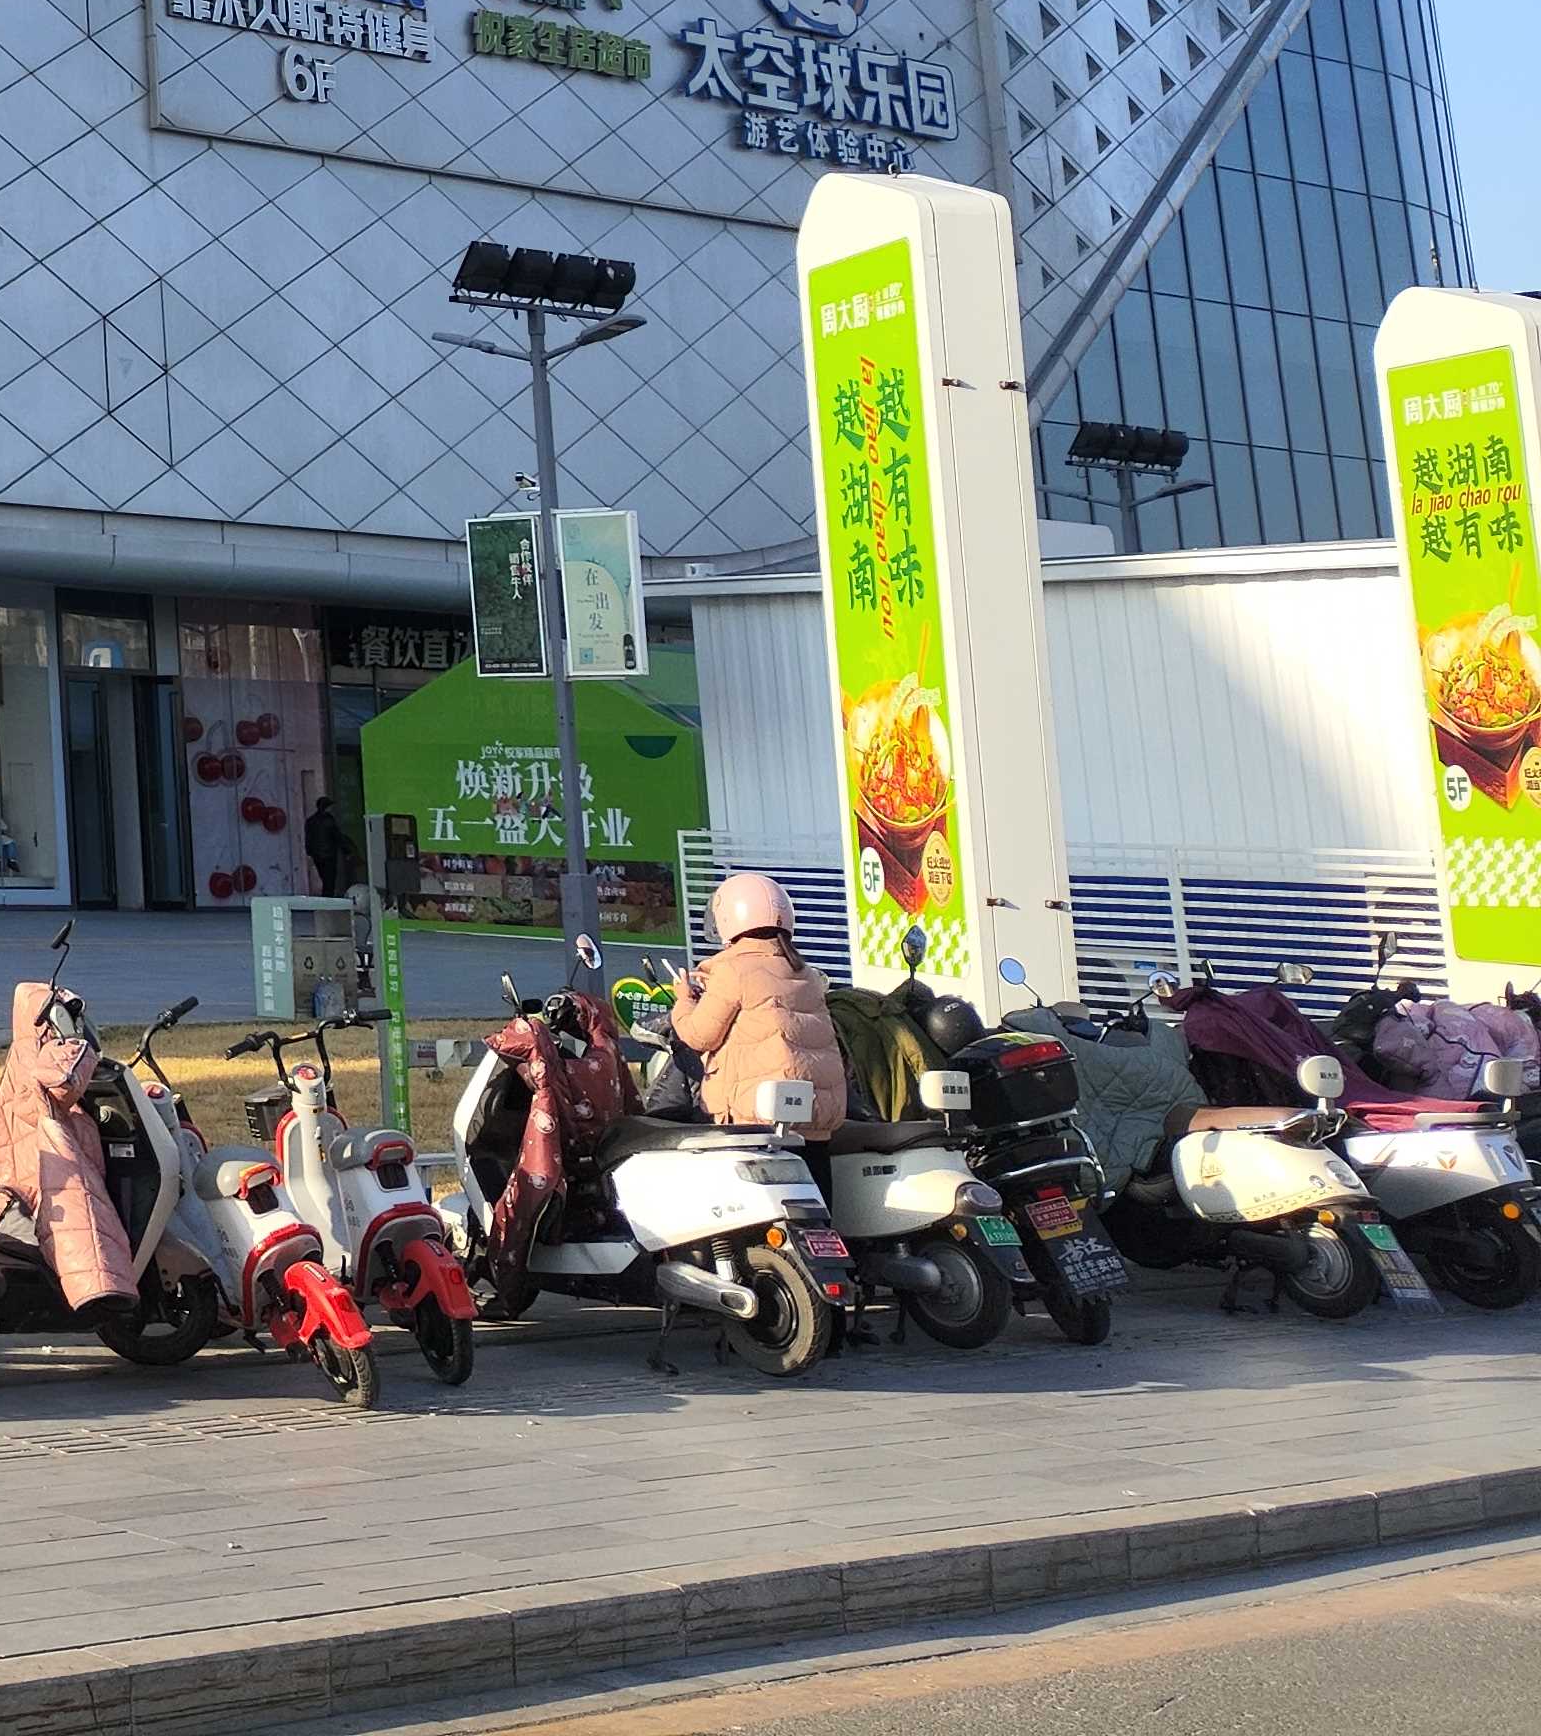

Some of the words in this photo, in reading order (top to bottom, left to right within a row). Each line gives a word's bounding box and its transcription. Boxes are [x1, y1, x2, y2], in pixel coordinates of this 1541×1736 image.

[281, 43, 338, 104] 6F
[472, 9, 653, 82] 悦家生活超市
[680, 17, 959, 141] 太空球乐园
[744, 111, 918, 172] 游艺体验中心
[820, 292, 870, 339] 周大厨
[859, 354, 876, 387] la
[1404, 387, 1463, 426] 周大厨
[833, 377, 878, 612] 越湖南
[875, 367, 926, 610] 越有味
[1412, 434, 1512, 495] 越湖南
[1411, 492, 1423, 515] la
[1429, 488, 1453, 518] jiao
[1459, 484, 1491, 508] chao
[1496, 483, 1523, 504] rou
[1421, 504, 1524, 563] 越有味
[1446, 776, 1469, 802] 5F
[863, 860, 881, 893] 5F
